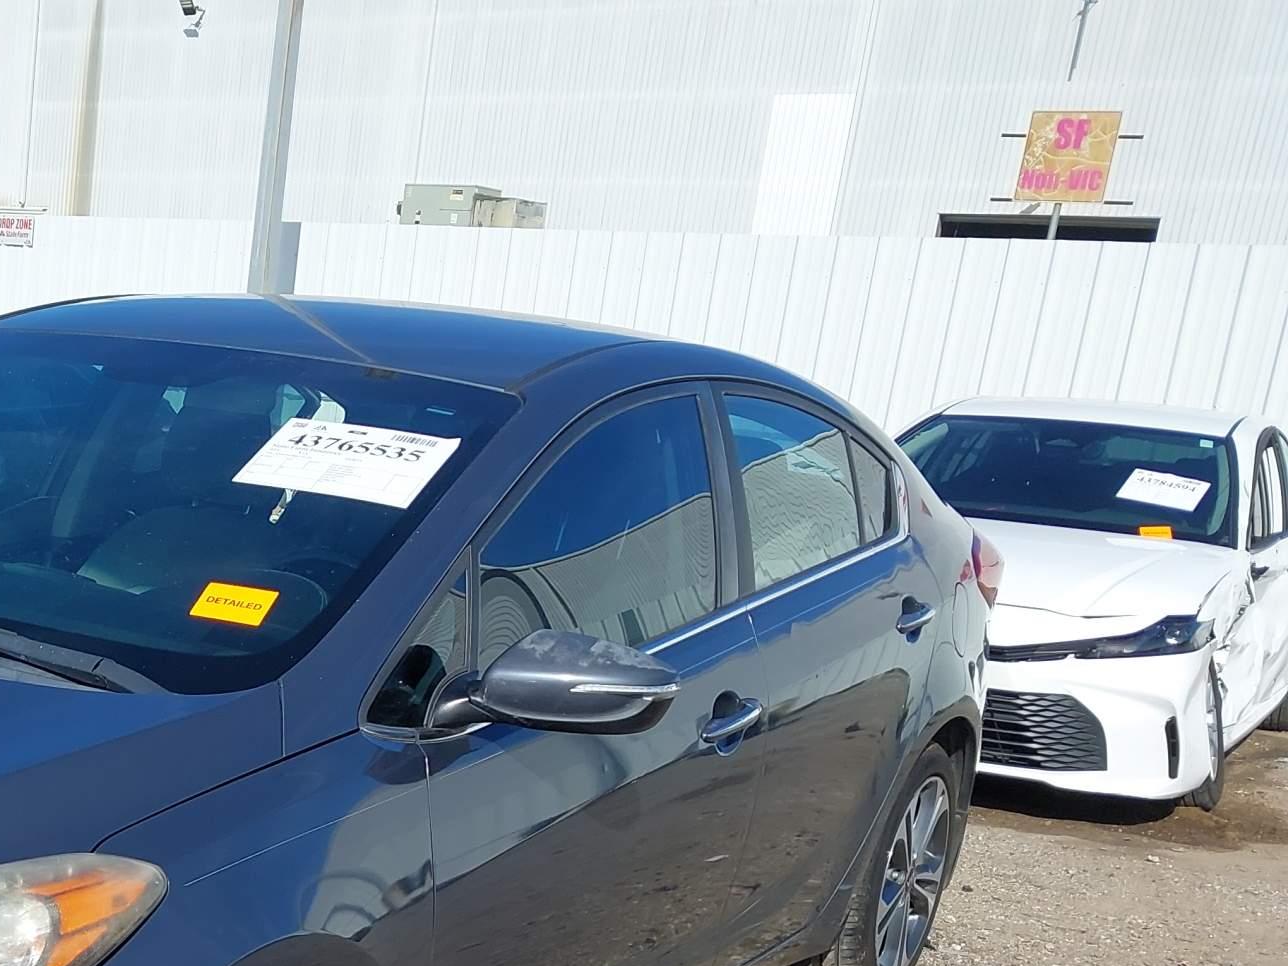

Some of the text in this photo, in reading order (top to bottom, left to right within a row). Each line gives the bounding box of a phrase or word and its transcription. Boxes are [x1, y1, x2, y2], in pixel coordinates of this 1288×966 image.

[1055, 117, 1091, 150] SF
[16, 218, 33, 230] ZONE
[288, 433, 427, 462] 43765535
[206, 595, 263, 611] DETAILED
